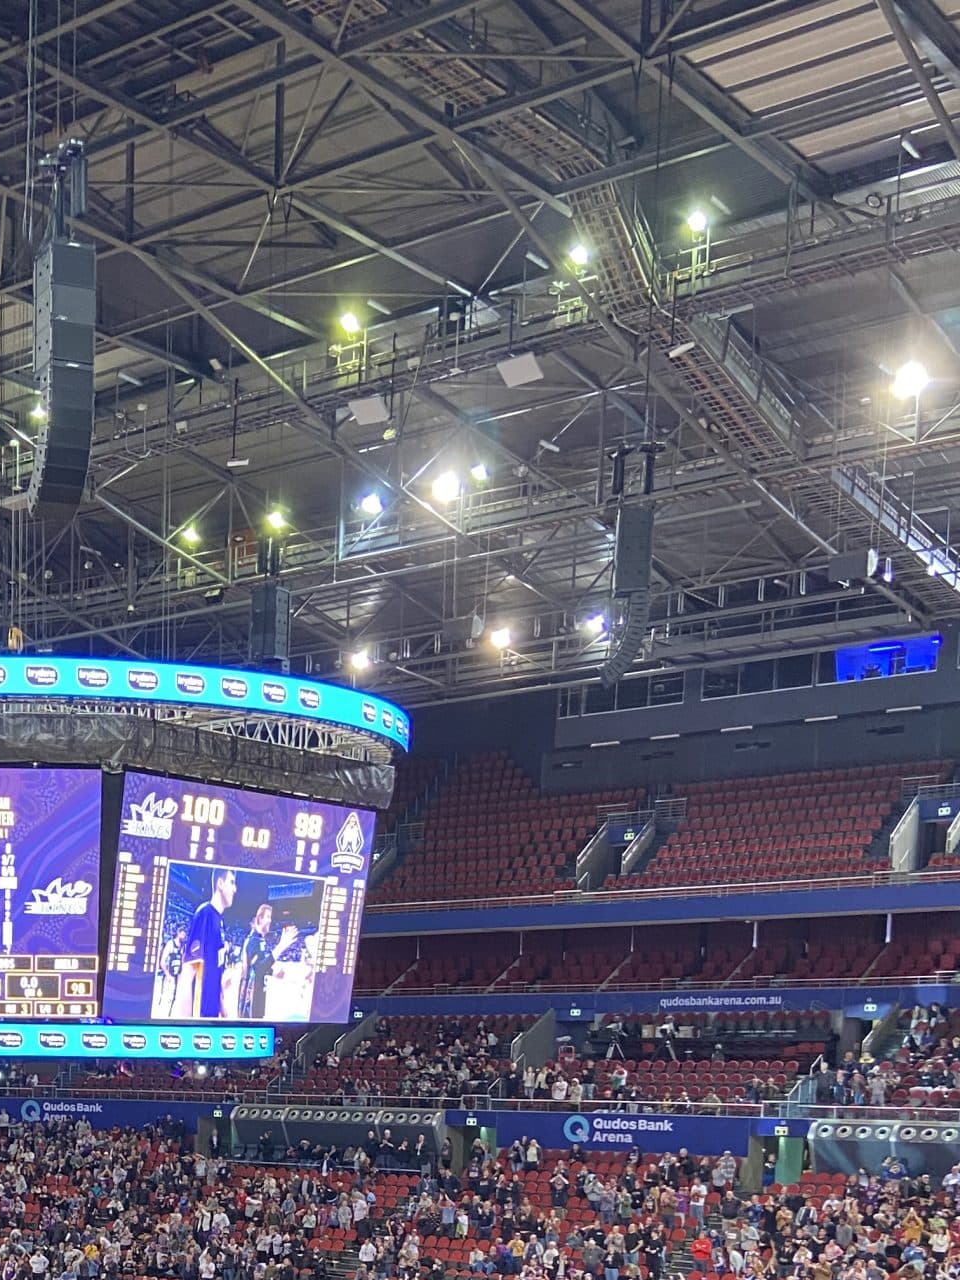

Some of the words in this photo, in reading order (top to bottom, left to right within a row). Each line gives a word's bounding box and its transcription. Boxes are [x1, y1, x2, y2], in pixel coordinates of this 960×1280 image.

[182, 795, 225, 825] 100
[295, 813, 322, 839] 98
[242, 827, 270, 849] 0.0
[20, 977, 38, 989] 0.0
[71, 983, 85, 994] 98
[660, 996, 781, 1008] qudosbankarena.com.au
[21, 1004, 28, 1014] 3
[57, 1004, 64, 1014] 0
[85, 1005, 92, 1015] 3
[43, 1102, 76, 1113] Qudos
[77, 1103, 103, 1113] Bank
[593, 1118, 637, 1130] Qudos
[638, 1120, 673, 1131] Bank
[593, 1131, 632, 1143] Arena
